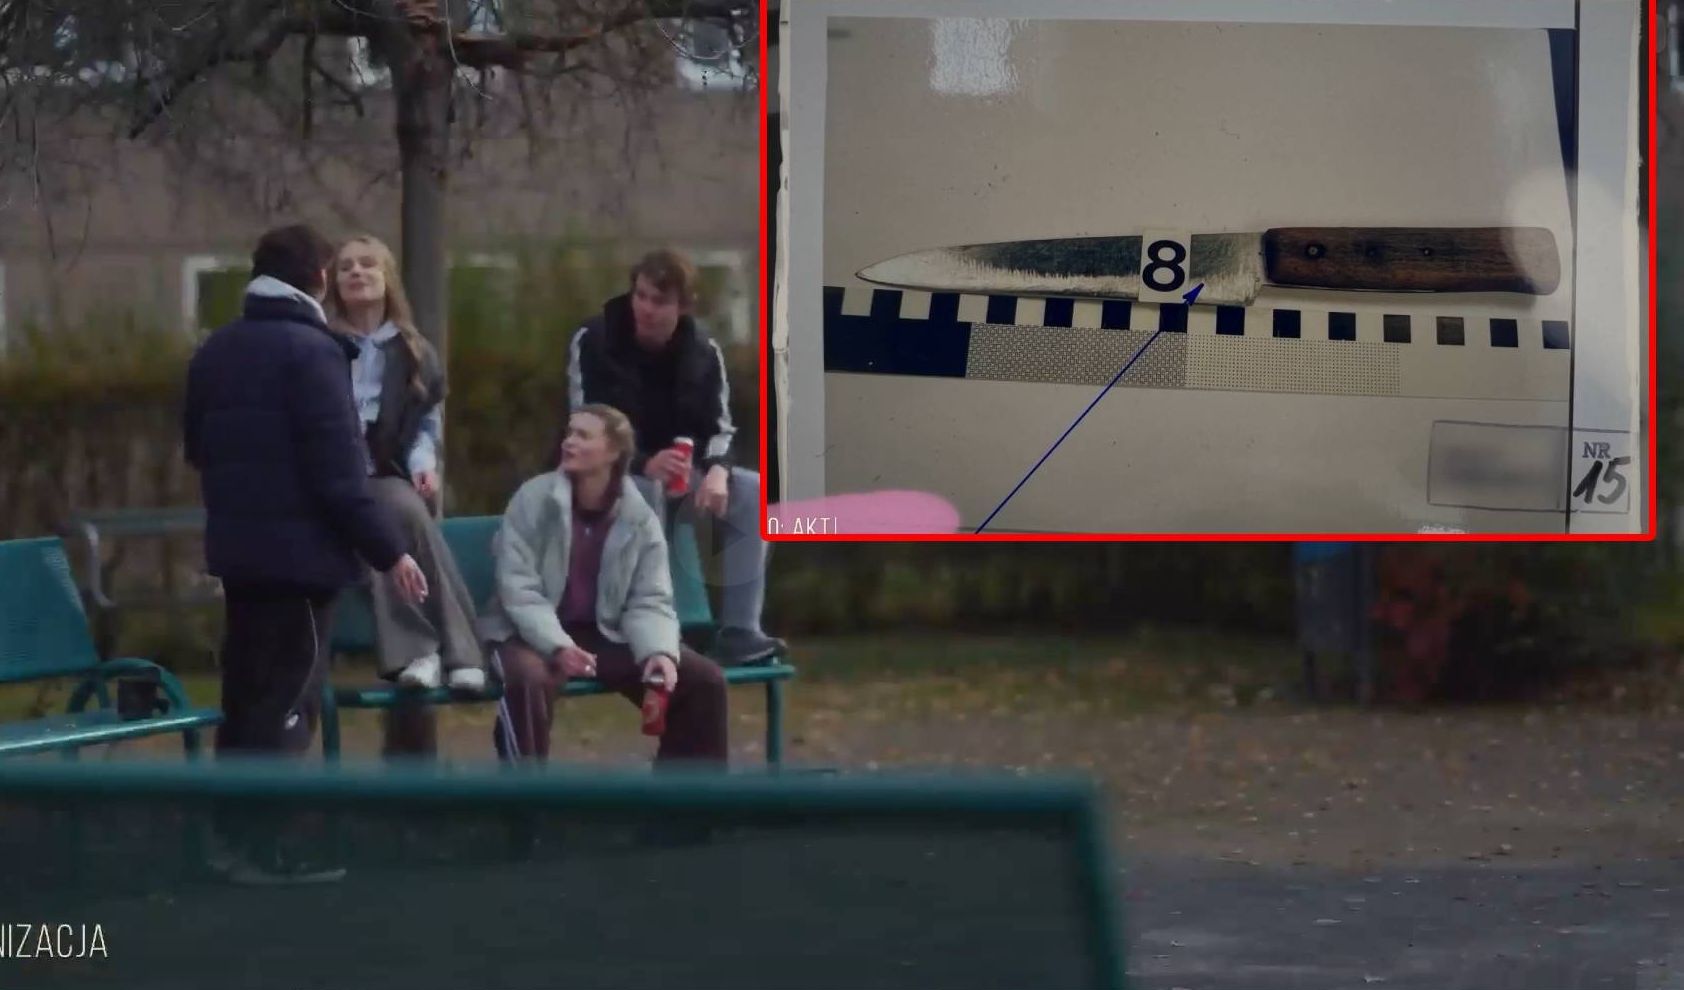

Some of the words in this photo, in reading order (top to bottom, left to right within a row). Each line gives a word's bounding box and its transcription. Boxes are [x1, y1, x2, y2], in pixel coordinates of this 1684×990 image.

[1142, 240, 1186, 292] 8
[1582, 441, 1611, 459] NR
[1572, 455, 1631, 505] 15
